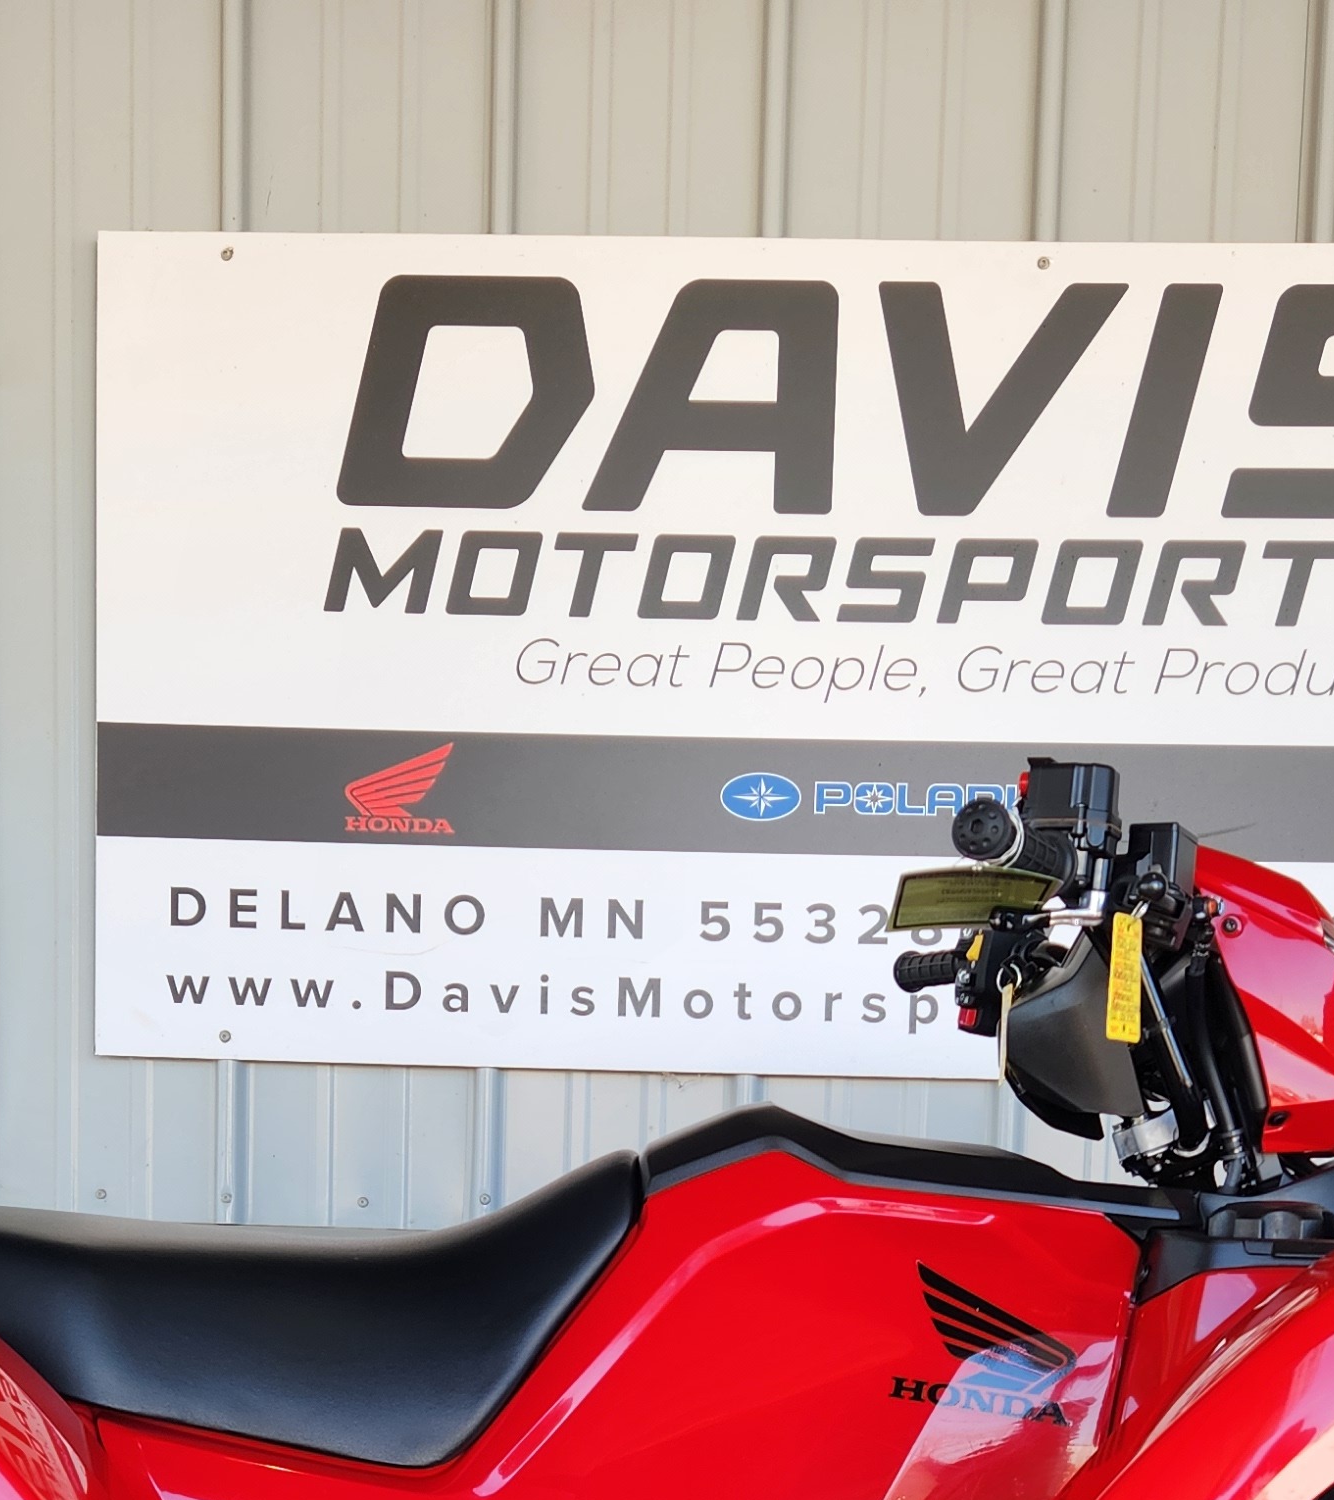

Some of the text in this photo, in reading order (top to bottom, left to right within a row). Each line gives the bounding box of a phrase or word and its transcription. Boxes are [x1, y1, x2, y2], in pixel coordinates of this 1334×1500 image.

[516, 637, 691, 688] Great
[709, 642, 927, 703] People,
[957, 645, 1136, 694] Great
[345, 815, 455, 835] HONDA
[813, 781, 1020, 817] POLARI
[170, 887, 487, 936] DELANO
[540, 898, 645, 940] MN
[166, 970, 940, 1035] www.DavisMotorsp
[888, 1376, 1073, 1428] HONDA
